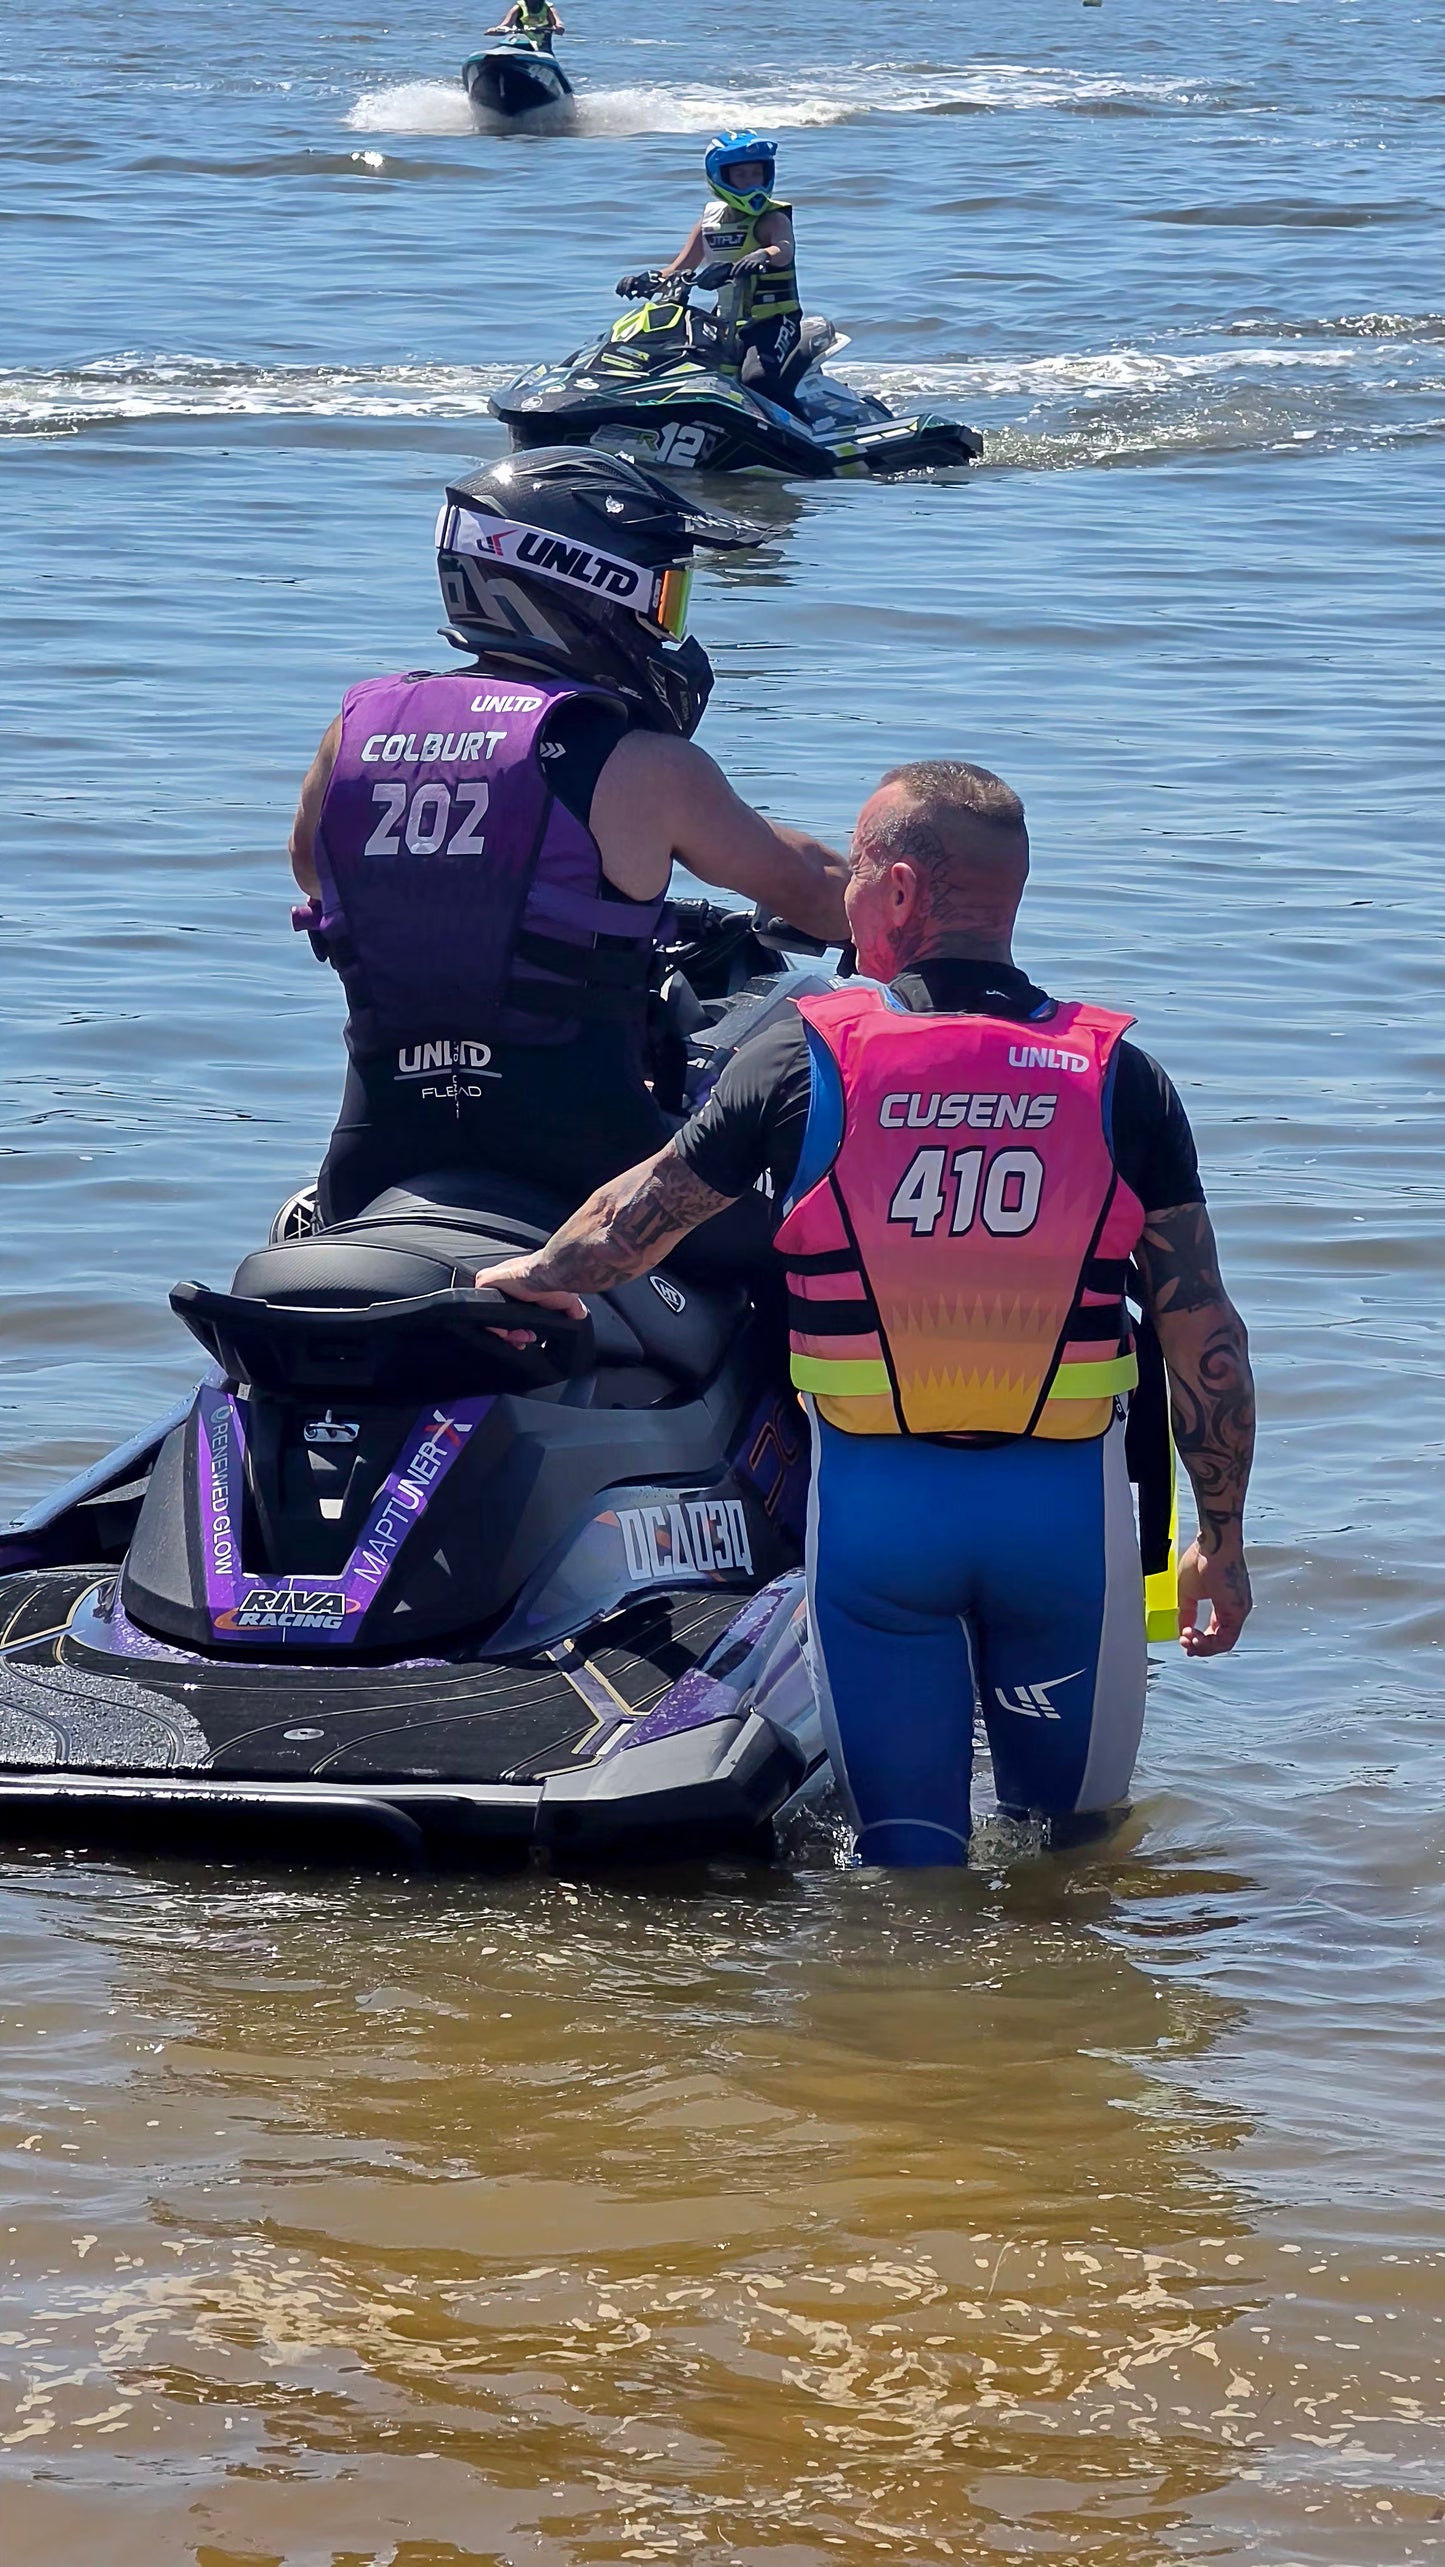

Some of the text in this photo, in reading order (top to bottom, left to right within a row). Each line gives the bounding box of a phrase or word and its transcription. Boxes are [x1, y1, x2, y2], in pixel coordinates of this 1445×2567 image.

[656, 421, 705, 468] 12
[516, 532, 640, 598] UNLTD
[470, 695, 543, 713] UNLTD
[360, 731, 508, 763] COLBURT
[363, 782, 490, 857] 202
[1008, 1045, 1090, 1074] UNLTD
[879, 1092, 1057, 1129] CUSENS
[887, 1145, 1045, 1238] 410
[210, 1422, 234, 1576] RENEWED GLOW
[238, 1612, 344, 1630] RACING
[239, 1589, 346, 1616] RIVA
